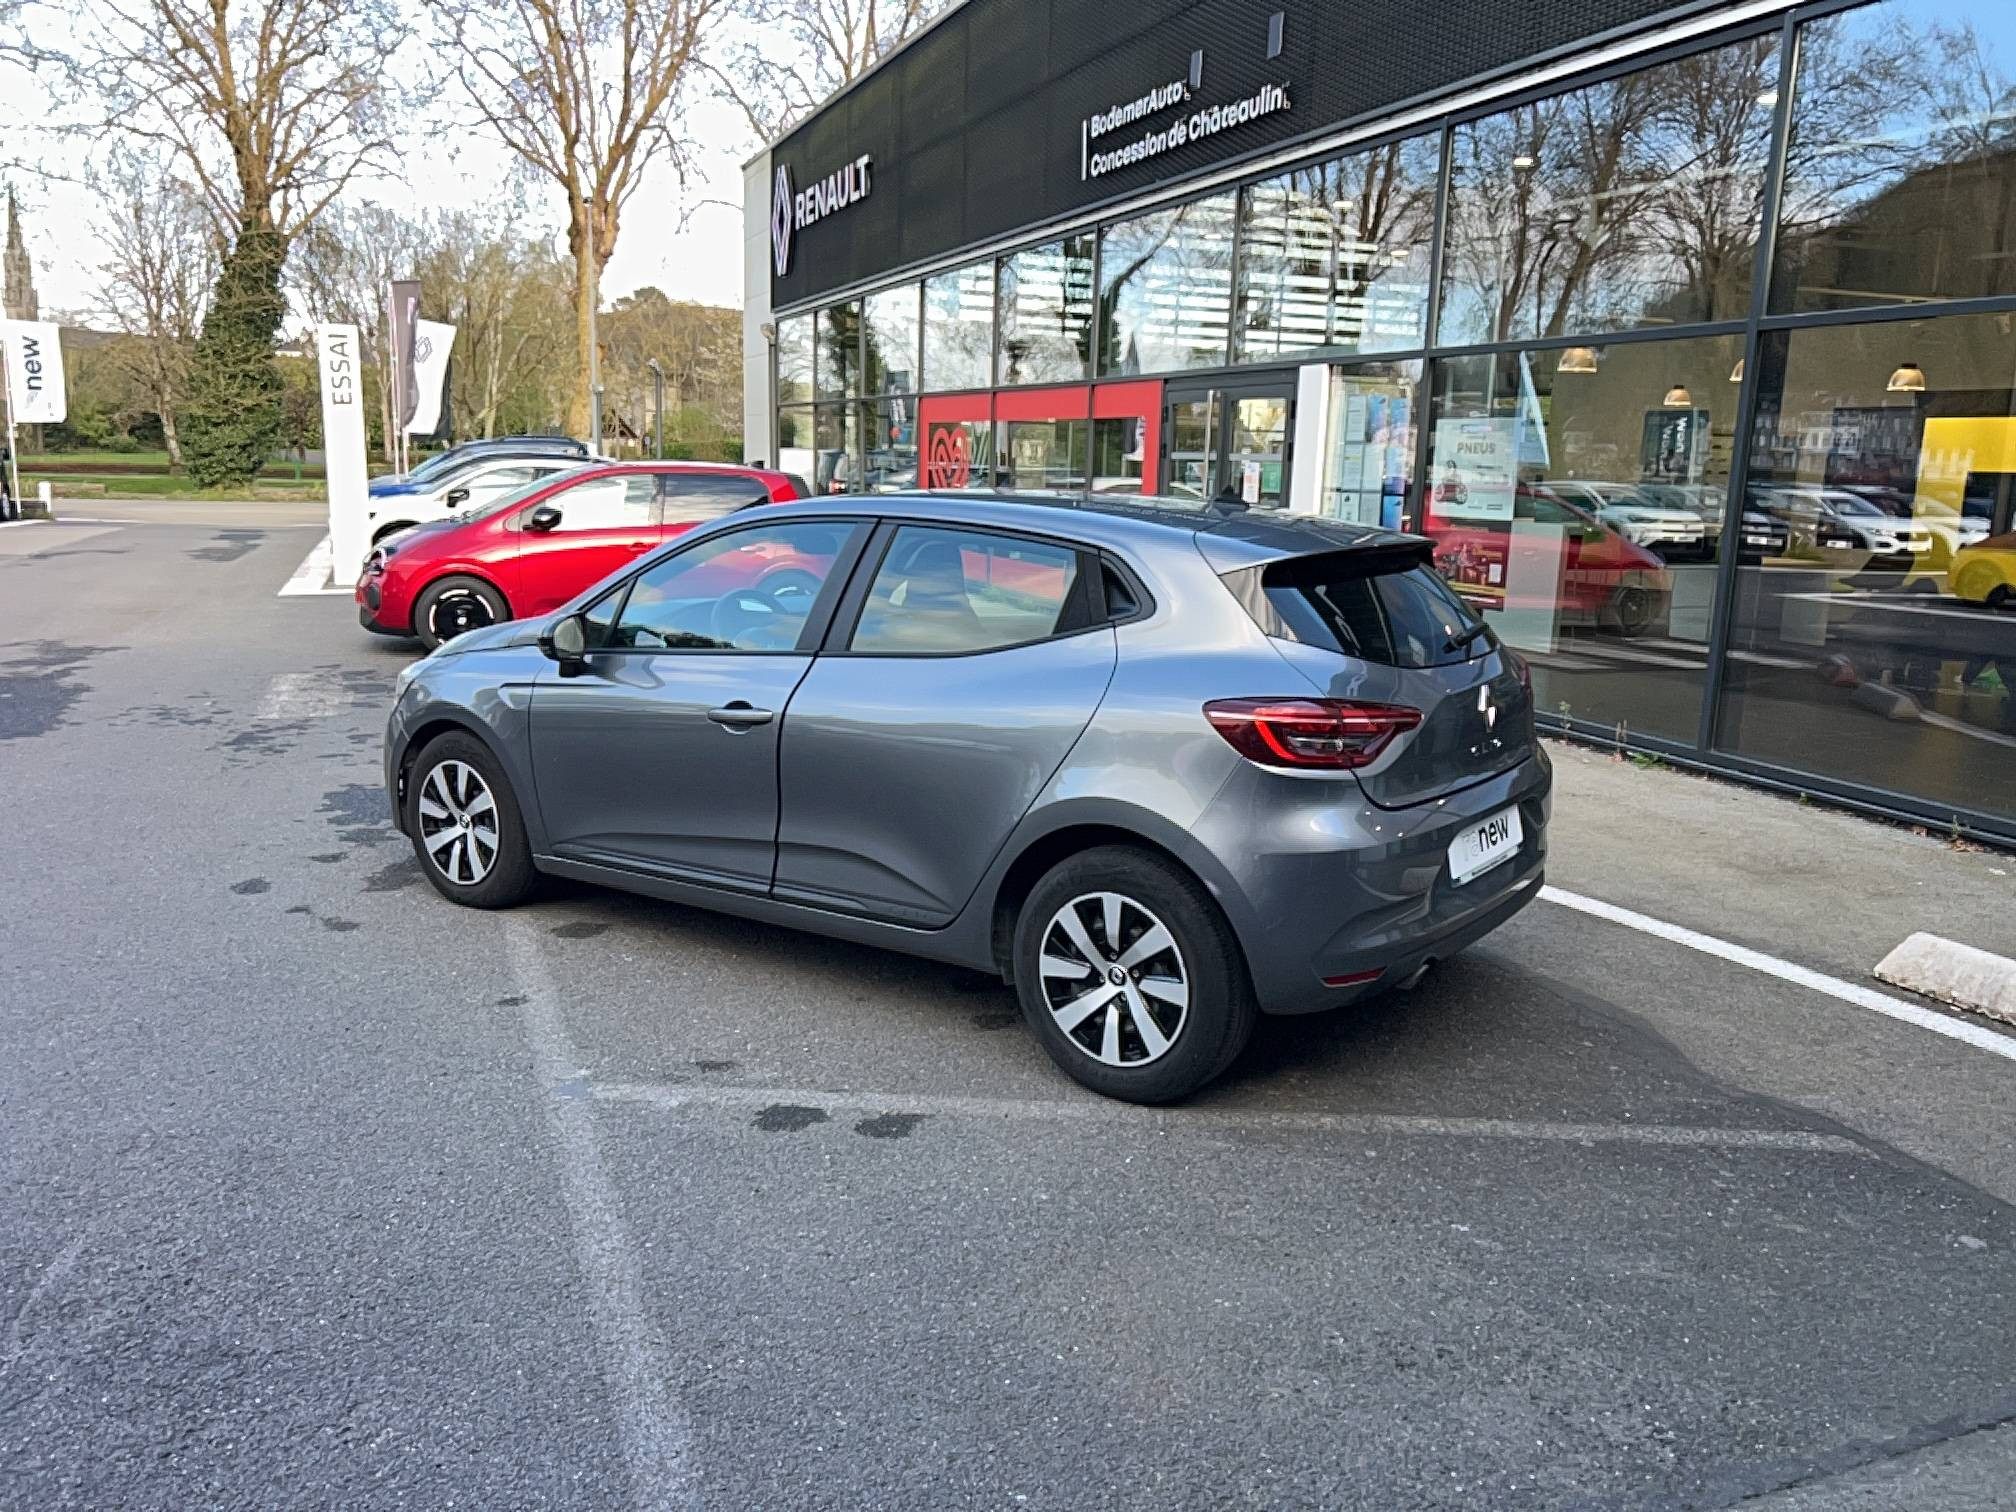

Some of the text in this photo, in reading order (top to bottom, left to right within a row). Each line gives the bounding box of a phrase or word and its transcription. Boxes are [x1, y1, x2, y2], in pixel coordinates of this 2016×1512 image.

[1090, 81, 1184, 138] BodemerAuto
[1090, 81, 1284, 177] Concession de Châteaulin
[795, 153, 870, 231] RENAULT
[328, 333, 352, 405] ESSAI
[1457, 441, 1496, 454] PNEUS
